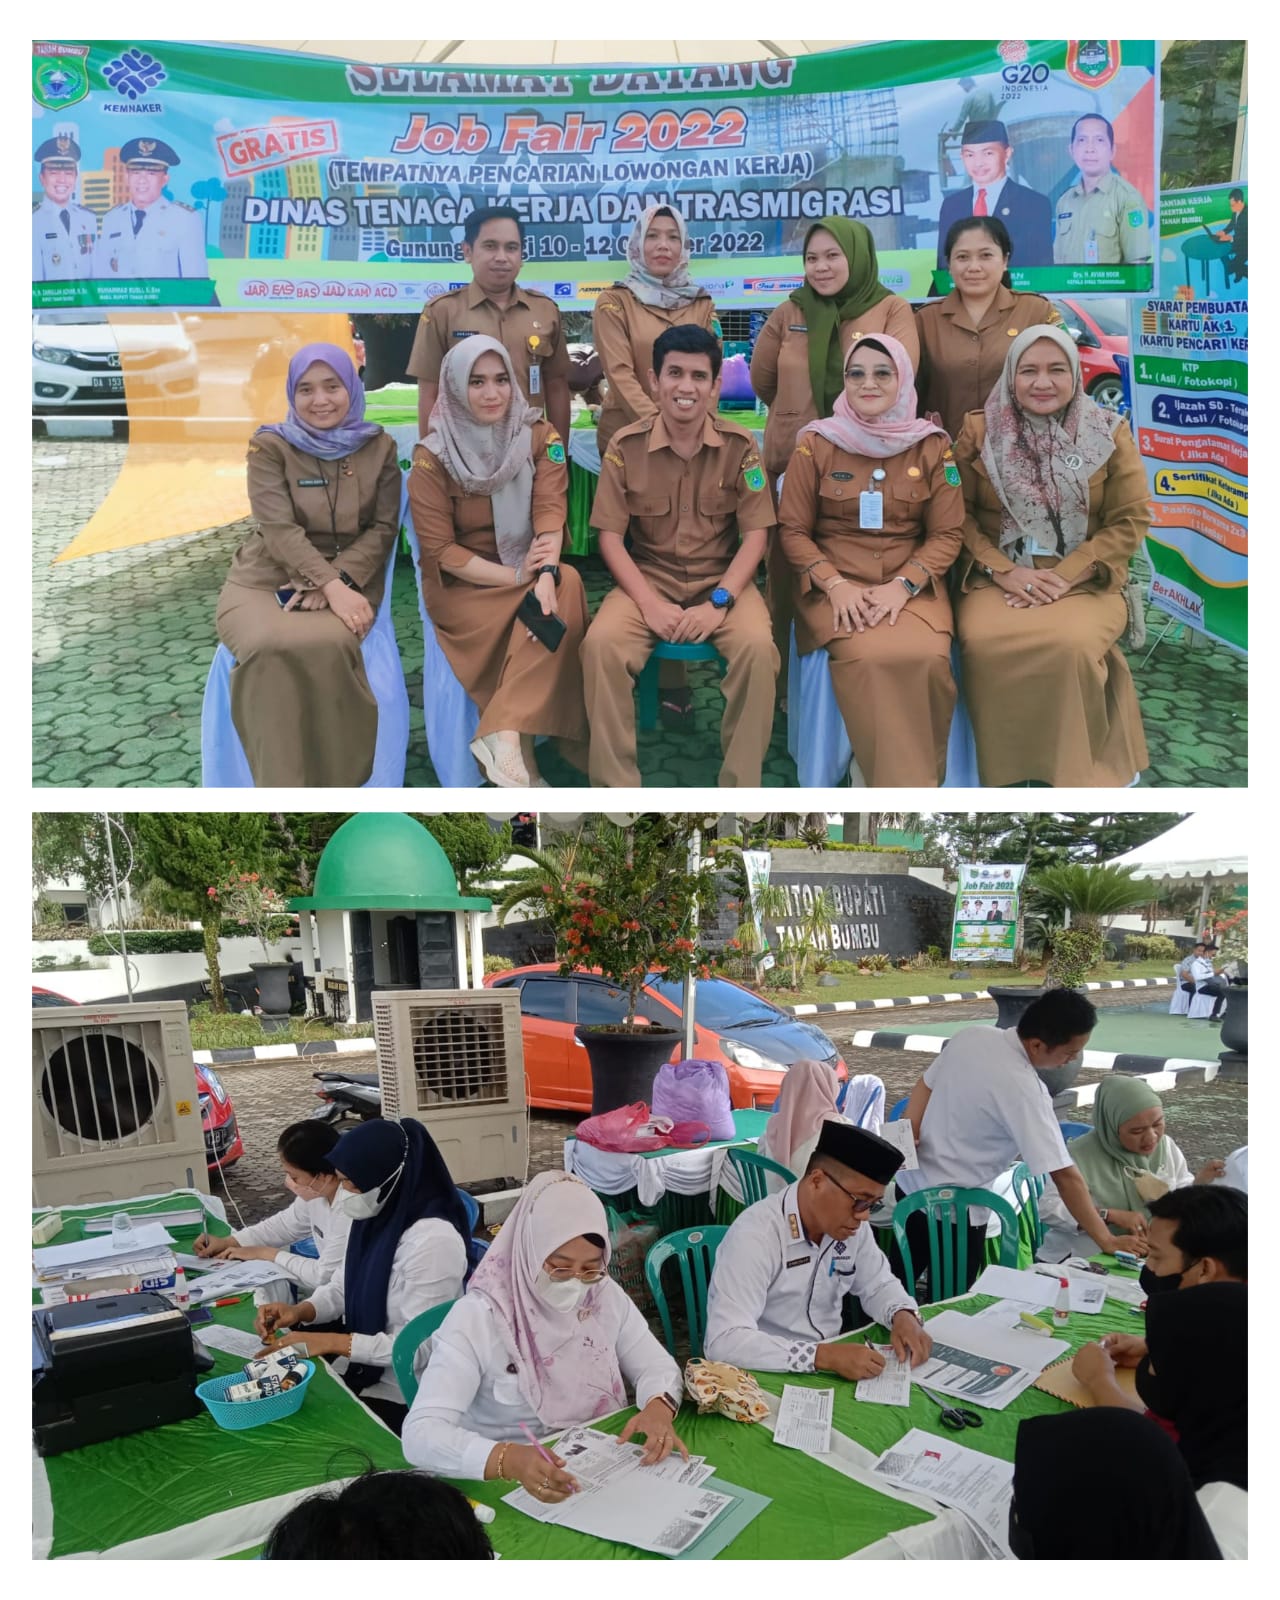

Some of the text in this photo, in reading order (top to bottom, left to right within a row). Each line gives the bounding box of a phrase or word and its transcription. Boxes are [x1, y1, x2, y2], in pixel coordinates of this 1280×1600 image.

[1001, 63, 1050, 84] G20
[104, 104, 162, 113] KEMNAKER
[392, 107, 748, 155] Job Fair 2022
[229, 129, 327, 166] GRATIS
[329, 152, 813, 187] (TEMPATNYA PENCARIAN LOWONGAN KERJA)
[243, 196, 348, 226] DINAS
[356, 197, 477, 227] TENAGA
[675, 187, 903, 221] TRASMIGRASI
[541, 235, 567, 252] 10
[585, 235, 612, 254] 12
[710, 232, 764, 252] 2022
[1147, 301, 1248, 314] SYARAT PEMBUATA
[1168, 319, 1234, 332] KARTU AK 1
[1140, 335, 1174, 347] (KARTU
[1176, 337, 1227, 351] PENCARI
[1182, 362, 1200, 372] KTP
[1208, 401, 1224, 411] SD
[1152, 580, 1201, 617] BerAKHLAK
[964, 882, 1015, 890] Job Fair 2022
[832, 883, 887, 916] BUPATI
[830, 923, 880, 950] BUMBU
